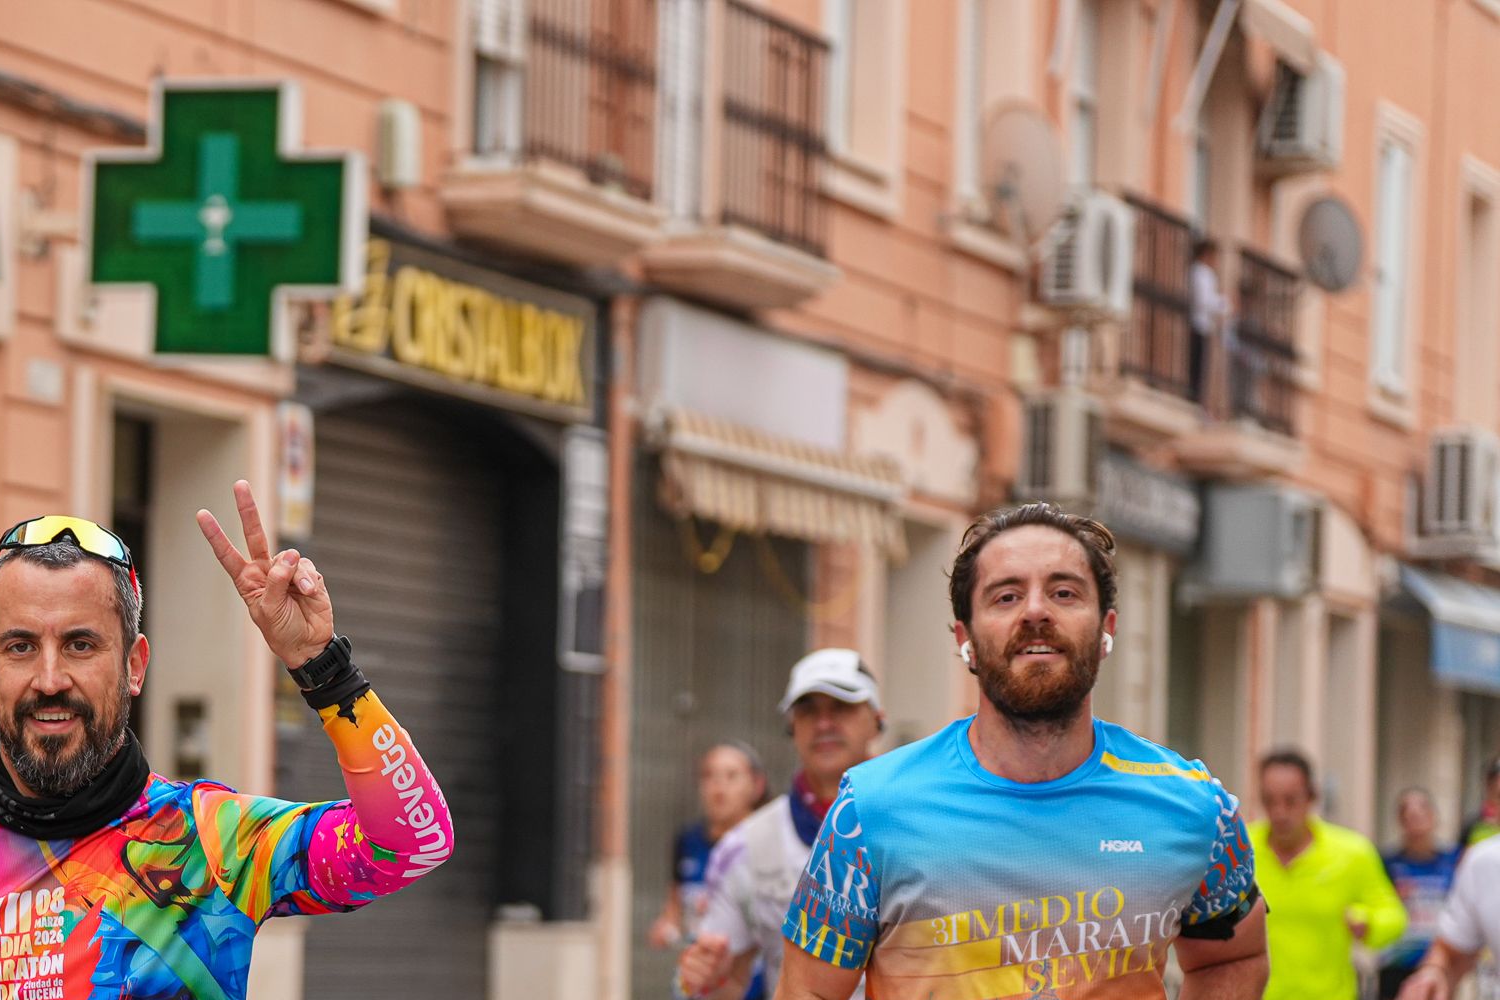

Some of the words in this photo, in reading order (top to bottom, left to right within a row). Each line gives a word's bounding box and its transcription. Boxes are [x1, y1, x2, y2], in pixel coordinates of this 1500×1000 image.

[372, 723, 450, 878] Muévete
[1100, 839, 1144, 853] HOKA
[35, 886, 65, 916] 08
[971, 886, 1125, 941] MEDIO
[34, 915, 65, 929] MARZO
[1003, 900, 1182, 966] MARATÓ
[34, 929, 65, 946] 2026
[53, 977, 64, 987] de
[1026, 943, 1157, 993] SEVILL
